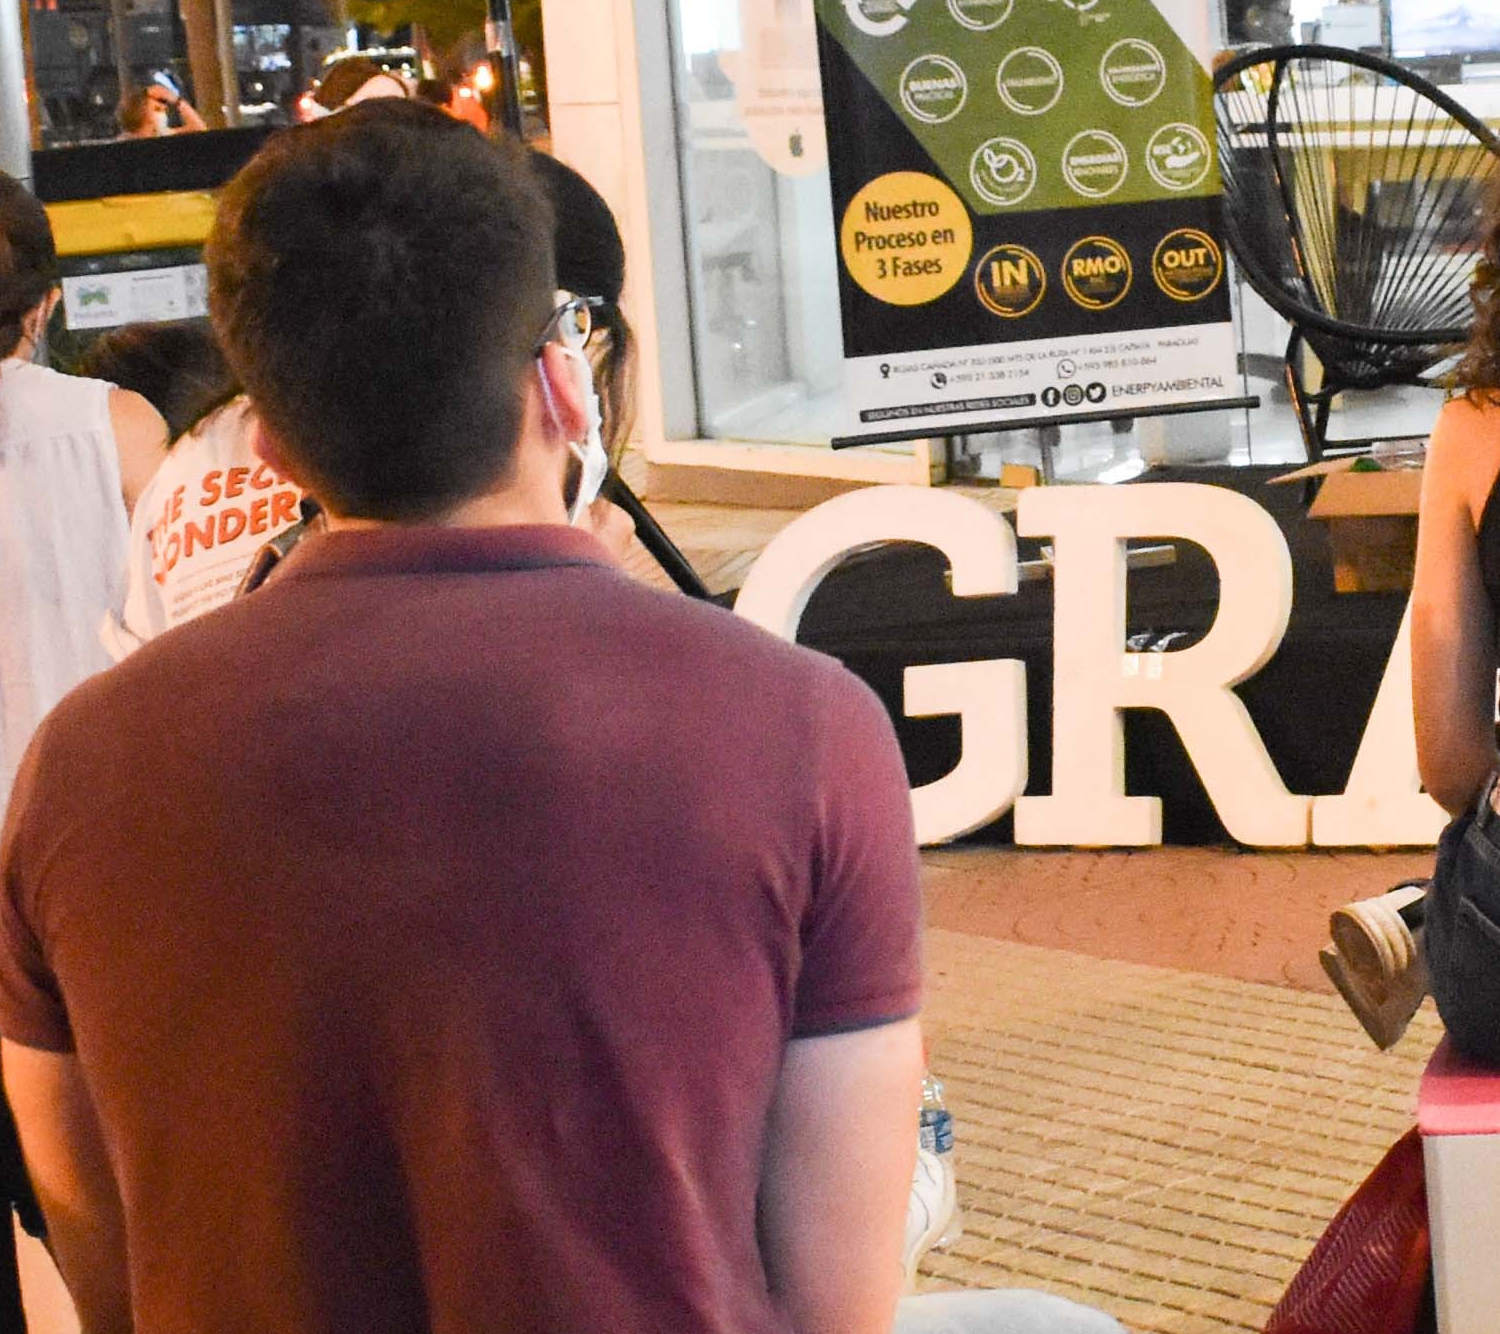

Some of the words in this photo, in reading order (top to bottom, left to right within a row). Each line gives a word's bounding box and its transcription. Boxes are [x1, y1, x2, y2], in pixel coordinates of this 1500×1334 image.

[864, 199, 940, 223] Nuestro
[854, 230, 927, 254] Proceso
[931, 228, 955, 247] en
[876, 258, 888, 279] 3
[892, 255, 943, 278] Fases
[1071, 255, 1121, 277] RMO
[1162, 248, 1207, 268] OUT
[990, 258, 1030, 288] IN
[199, 460, 290, 507] SEC
